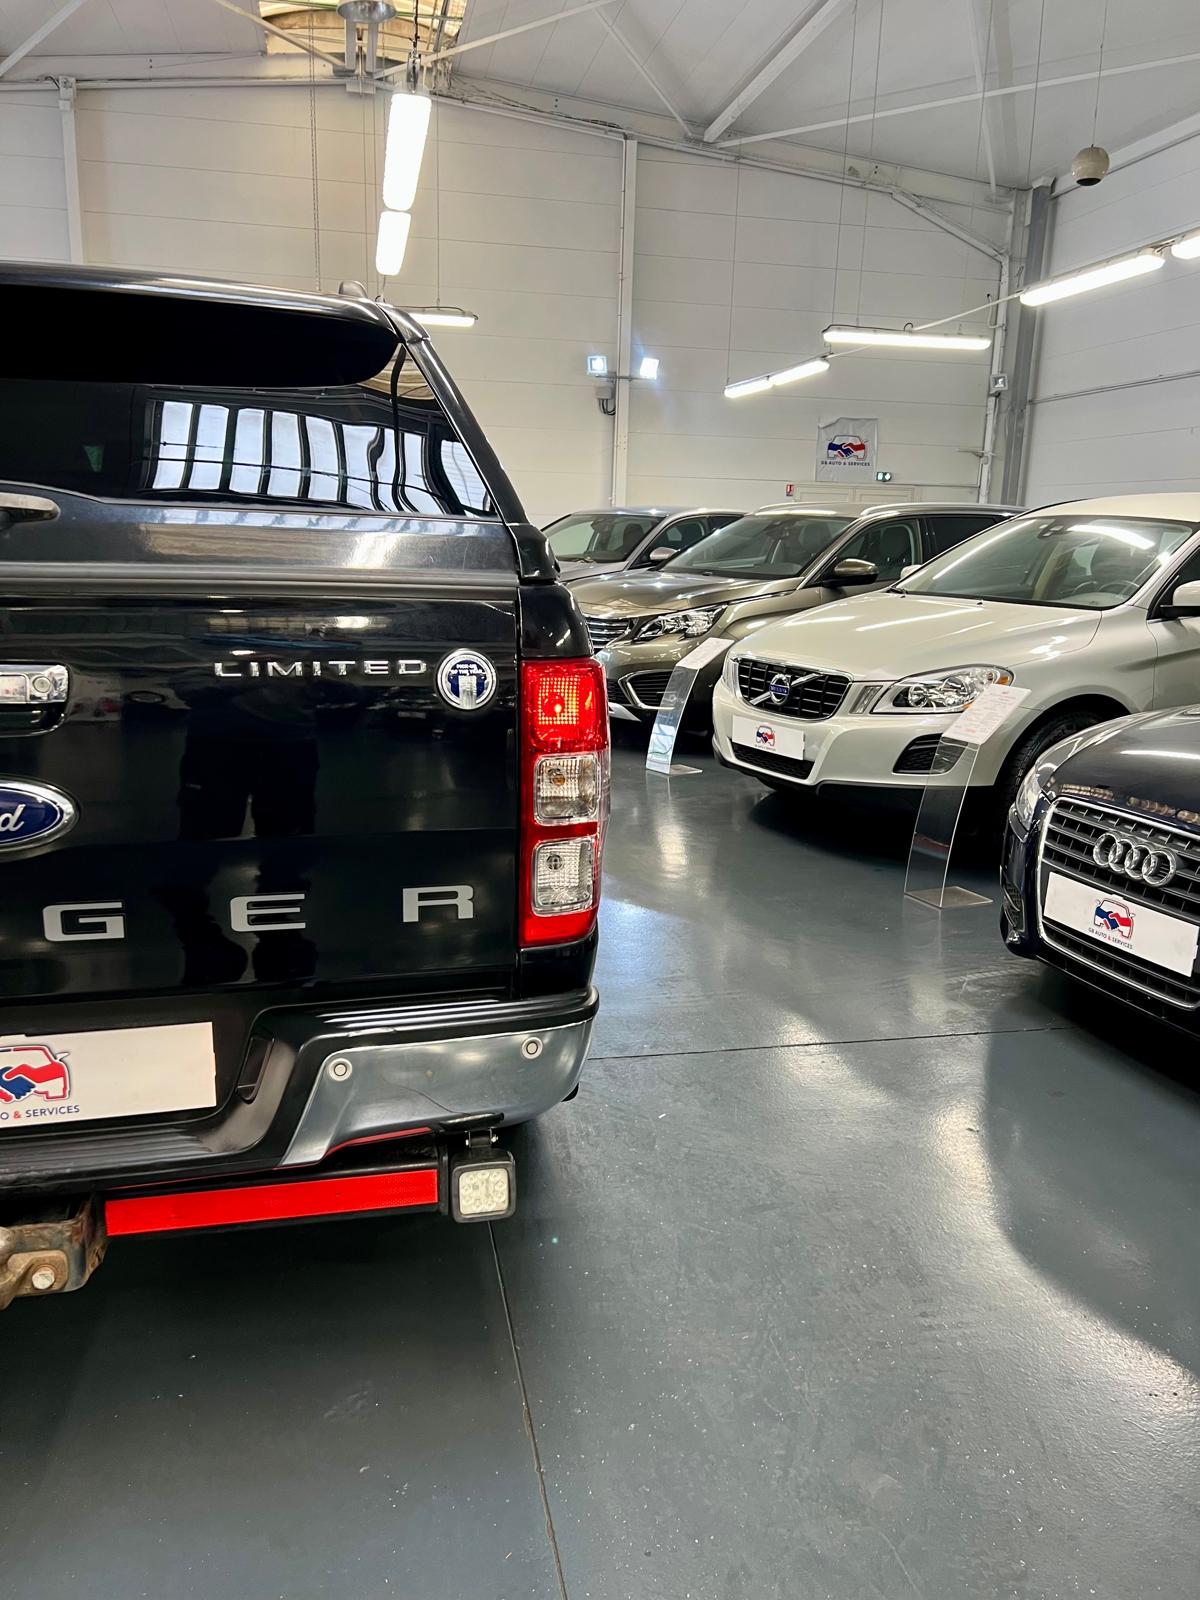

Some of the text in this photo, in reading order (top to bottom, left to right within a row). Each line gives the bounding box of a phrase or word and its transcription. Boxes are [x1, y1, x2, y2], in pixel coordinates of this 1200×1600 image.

[214, 659, 427, 677] LIMITED
[1112, 937, 1133, 949] SERVICES
[13, 1110, 22, 1119] &
[25, 1105, 80, 1118] SERVICES
